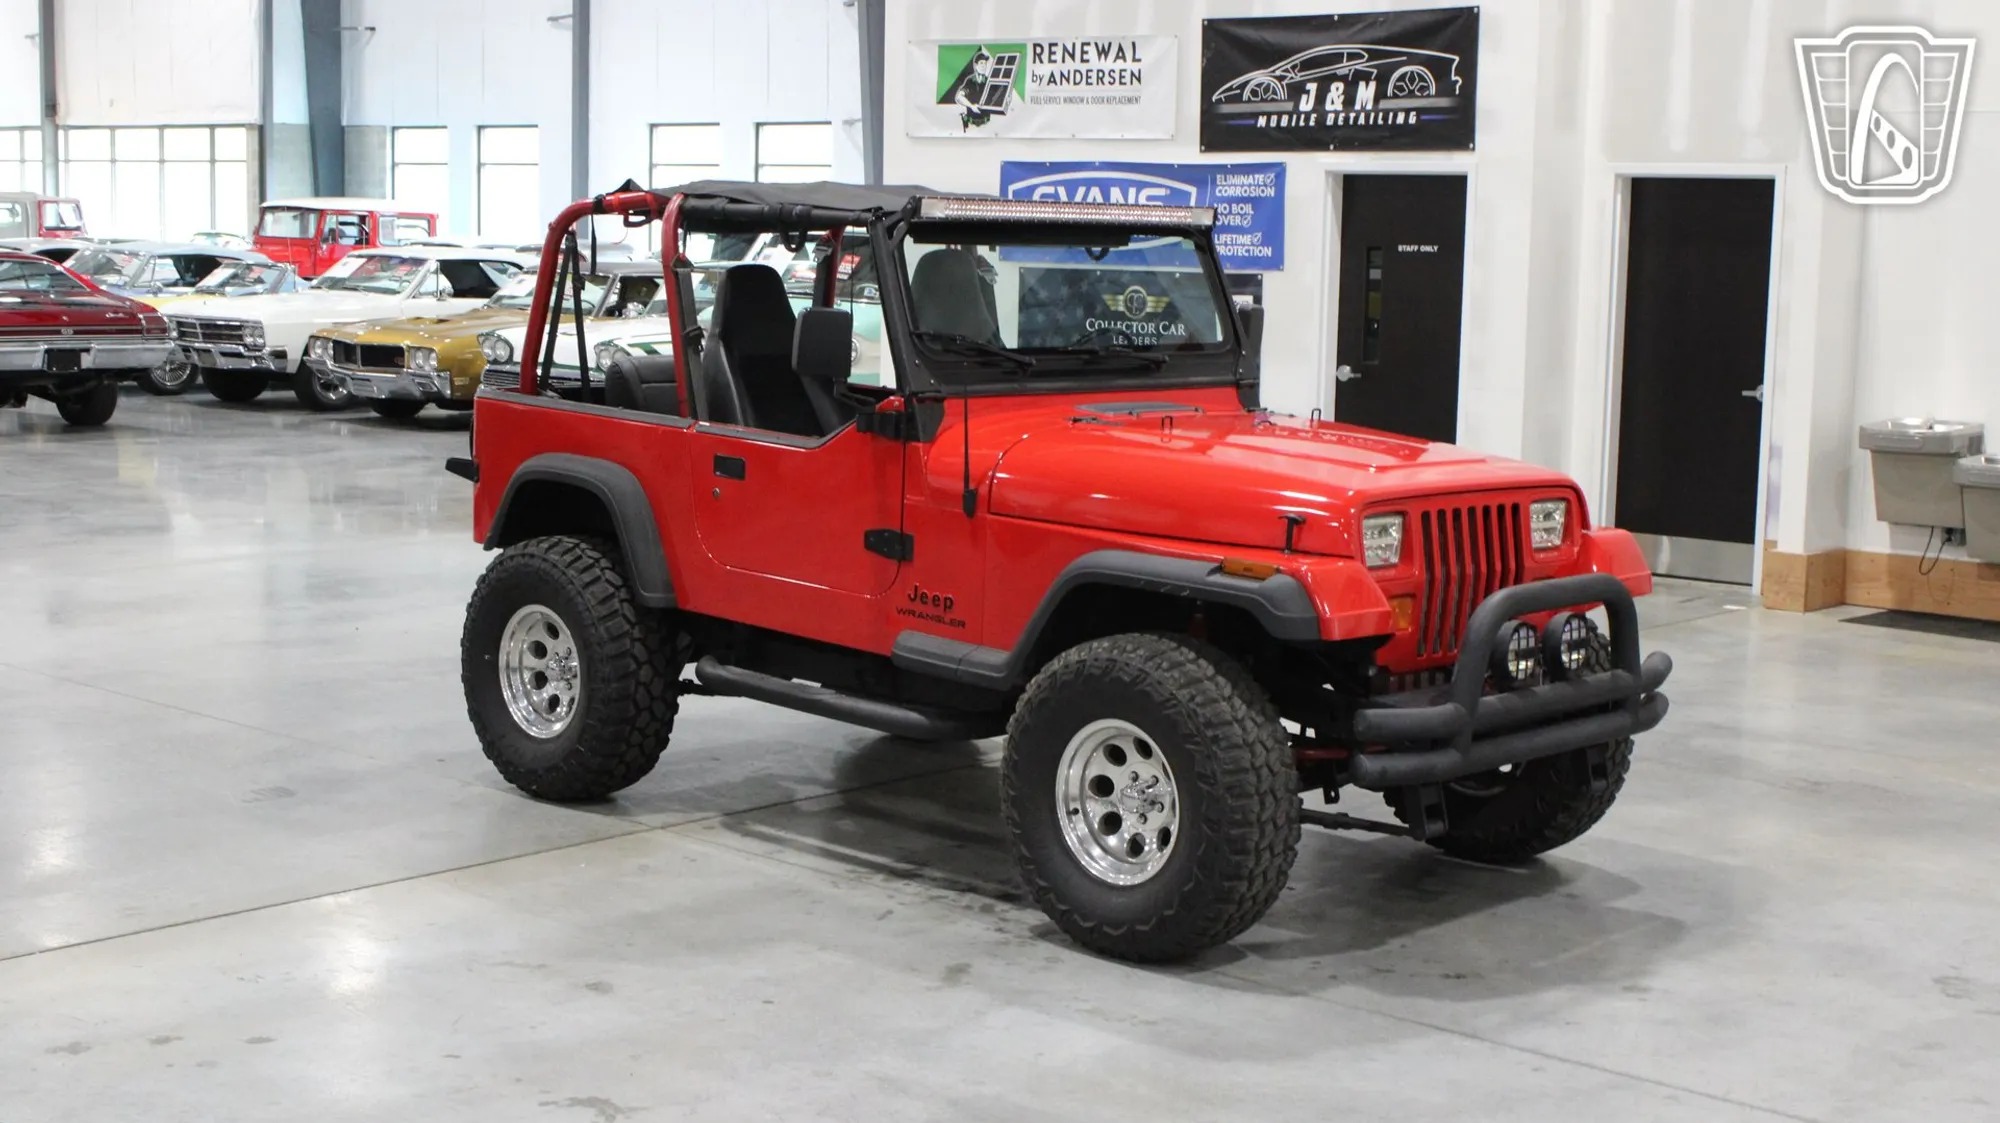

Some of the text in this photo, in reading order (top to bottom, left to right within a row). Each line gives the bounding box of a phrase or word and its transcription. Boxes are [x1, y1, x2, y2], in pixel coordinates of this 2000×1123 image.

[1032, 41, 1142, 64] RENEWAL
[1031, 68, 1142, 86] by ANDERSEN
[1062, 95, 1085, 105] WINDOW
[1105, 95, 1141, 105] REPLACEMENT
[1299, 80, 1377, 112] J & M
[1256, 110, 1417, 128] MOBILE DETAILING
[1216, 174, 1265, 186] ELIMINATE
[1215, 186, 1275, 197] CORROSION
[1214, 203, 1255, 215] NO BOIL
[1215, 215, 1242, 226] OVER
[1214, 233, 1253, 245] LIFETIME
[1215, 245, 1273, 257] PROTECTION
[1397, 244, 1439, 252] STAFF ONLY
[1158, 320, 1186, 336] CAR
[1112, 335, 1159, 346] LEDERS
[907, 582, 954, 613] Jeep
[896, 607, 966, 628] WRANGLER
